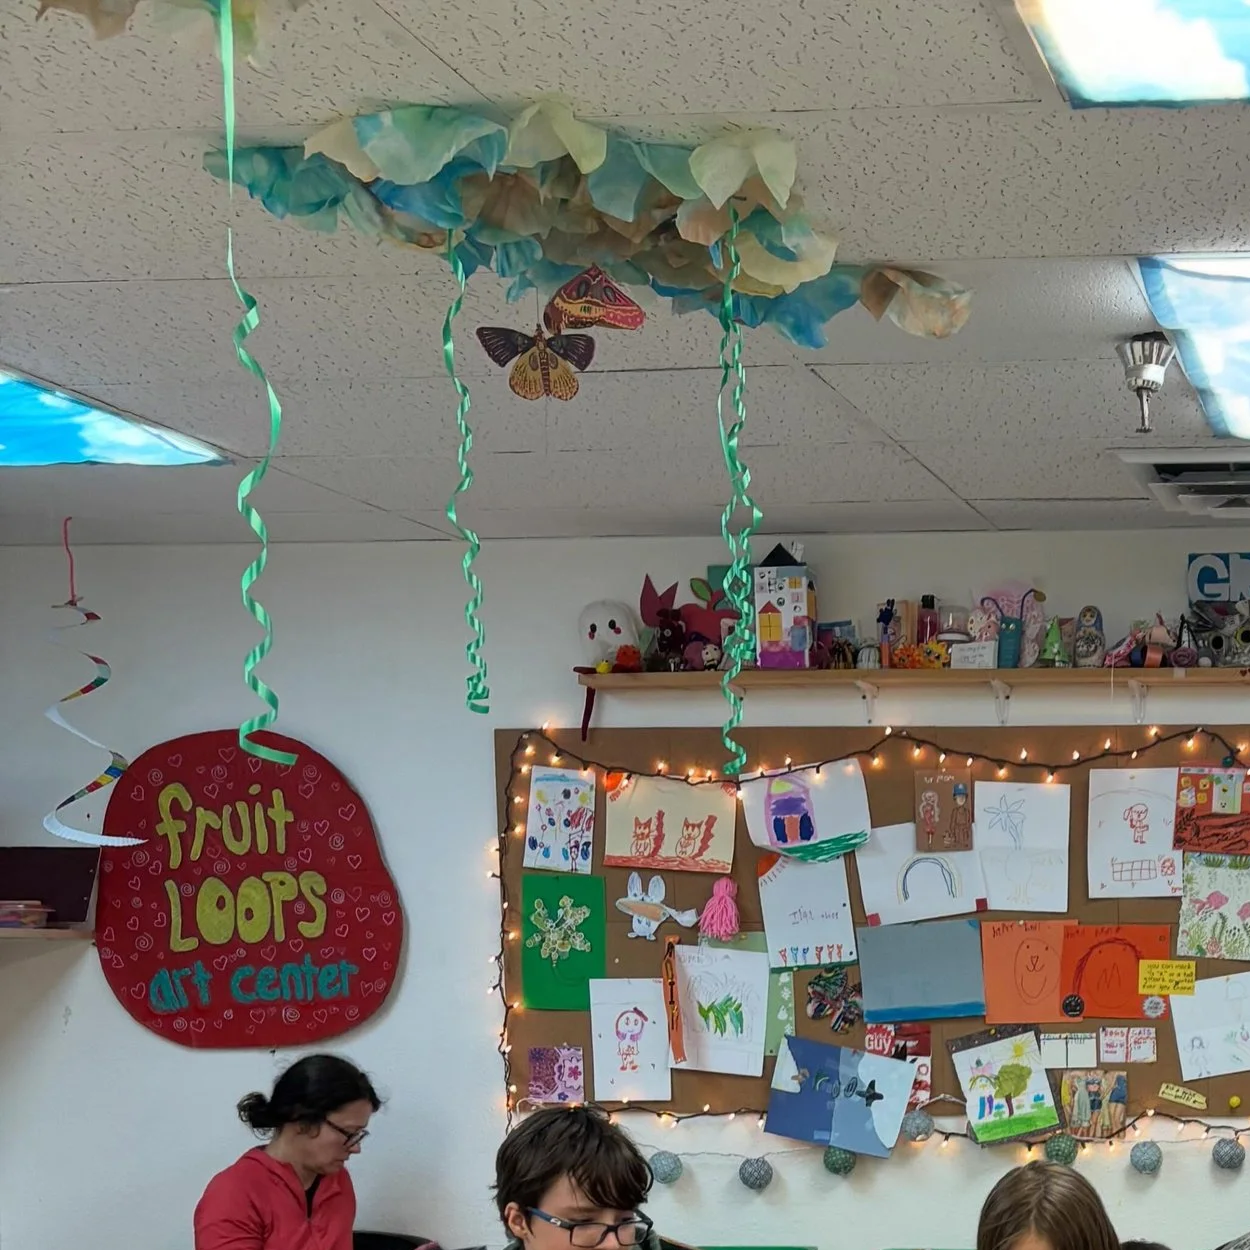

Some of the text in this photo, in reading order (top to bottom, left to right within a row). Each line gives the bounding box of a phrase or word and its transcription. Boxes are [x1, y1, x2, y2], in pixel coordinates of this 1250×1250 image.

[164, 871, 327, 952] LOOPS
[150, 953, 358, 1014] art center
